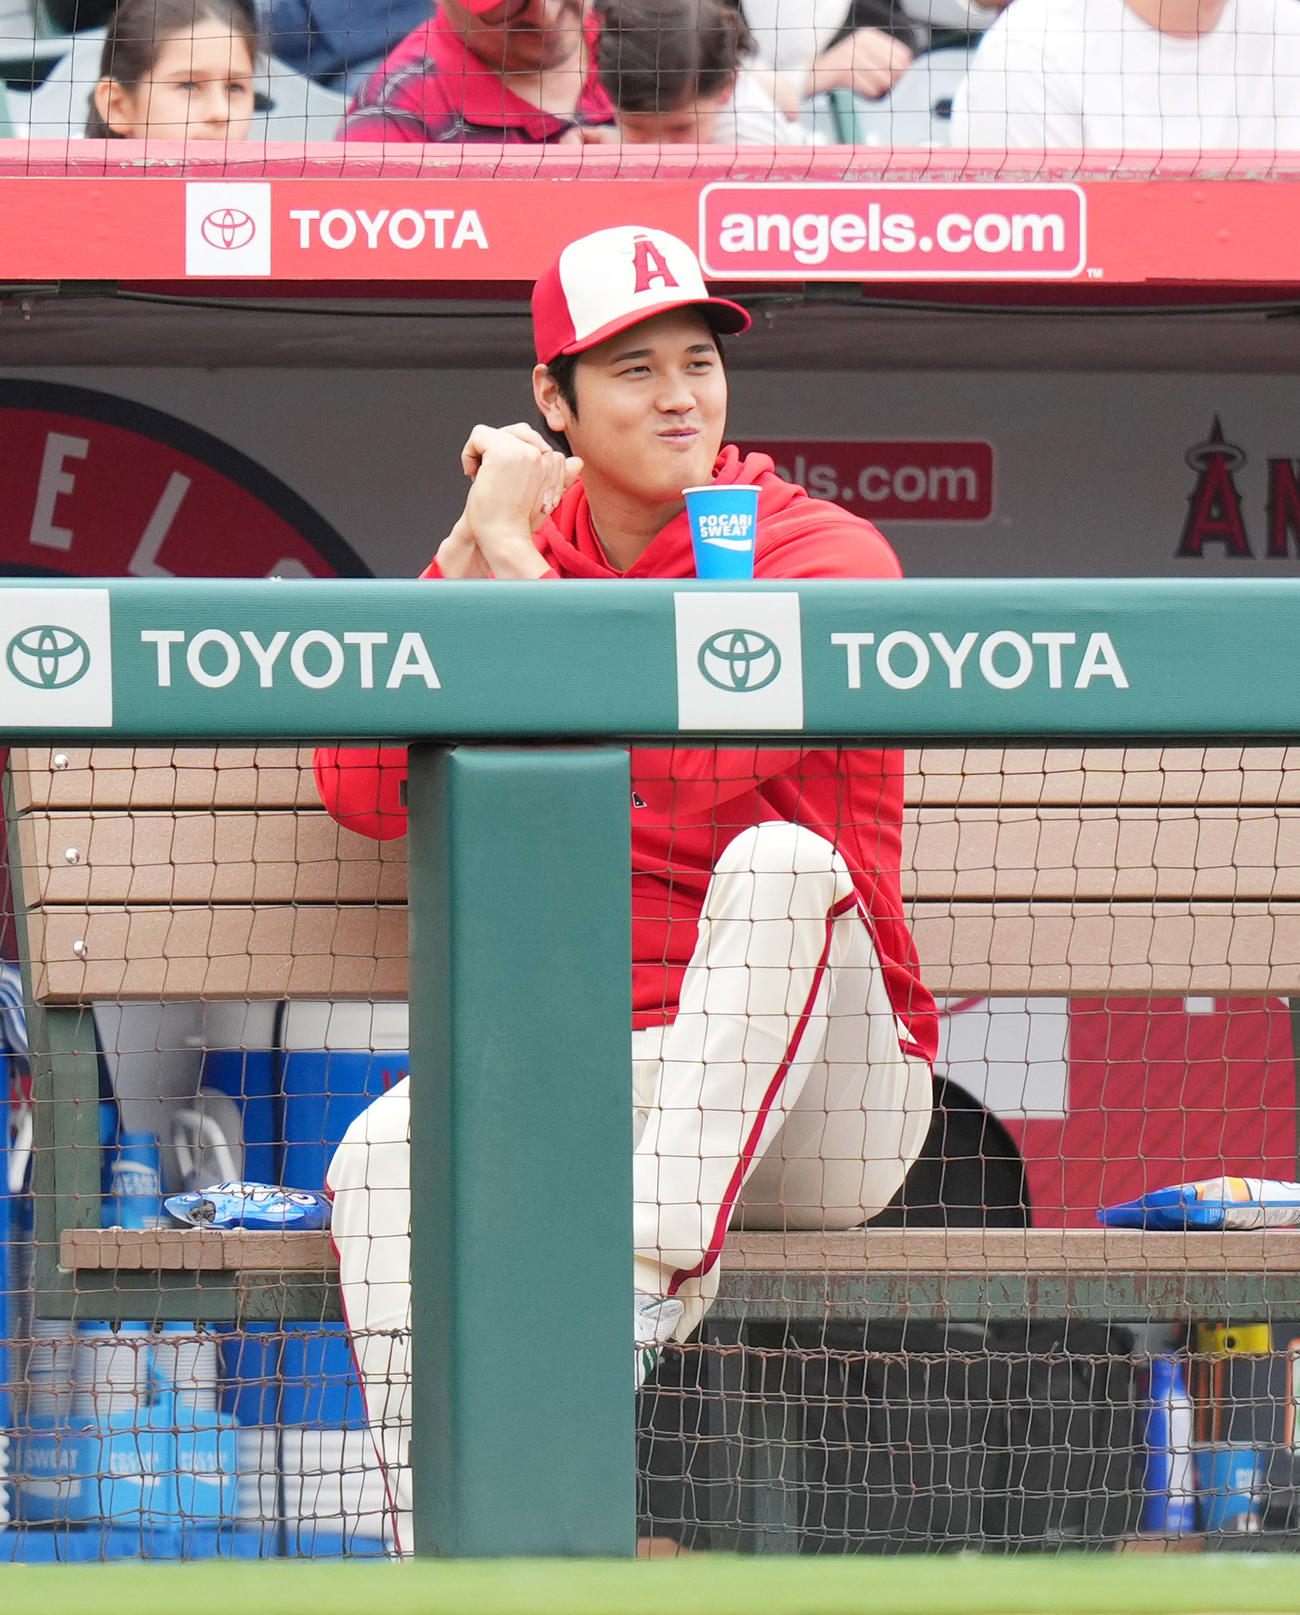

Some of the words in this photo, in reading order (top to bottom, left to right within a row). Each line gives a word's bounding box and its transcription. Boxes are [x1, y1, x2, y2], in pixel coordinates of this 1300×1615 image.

[289, 209, 489, 249] TOYOTA
[719, 203, 1065, 264] angels.com
[632, 234, 680, 294] A
[699, 513, 752, 528] POCARI
[700, 525, 748, 538] SWEAT
[141, 629, 442, 689] TOYOTA
[830, 630, 1130, 690] TOYOTA
